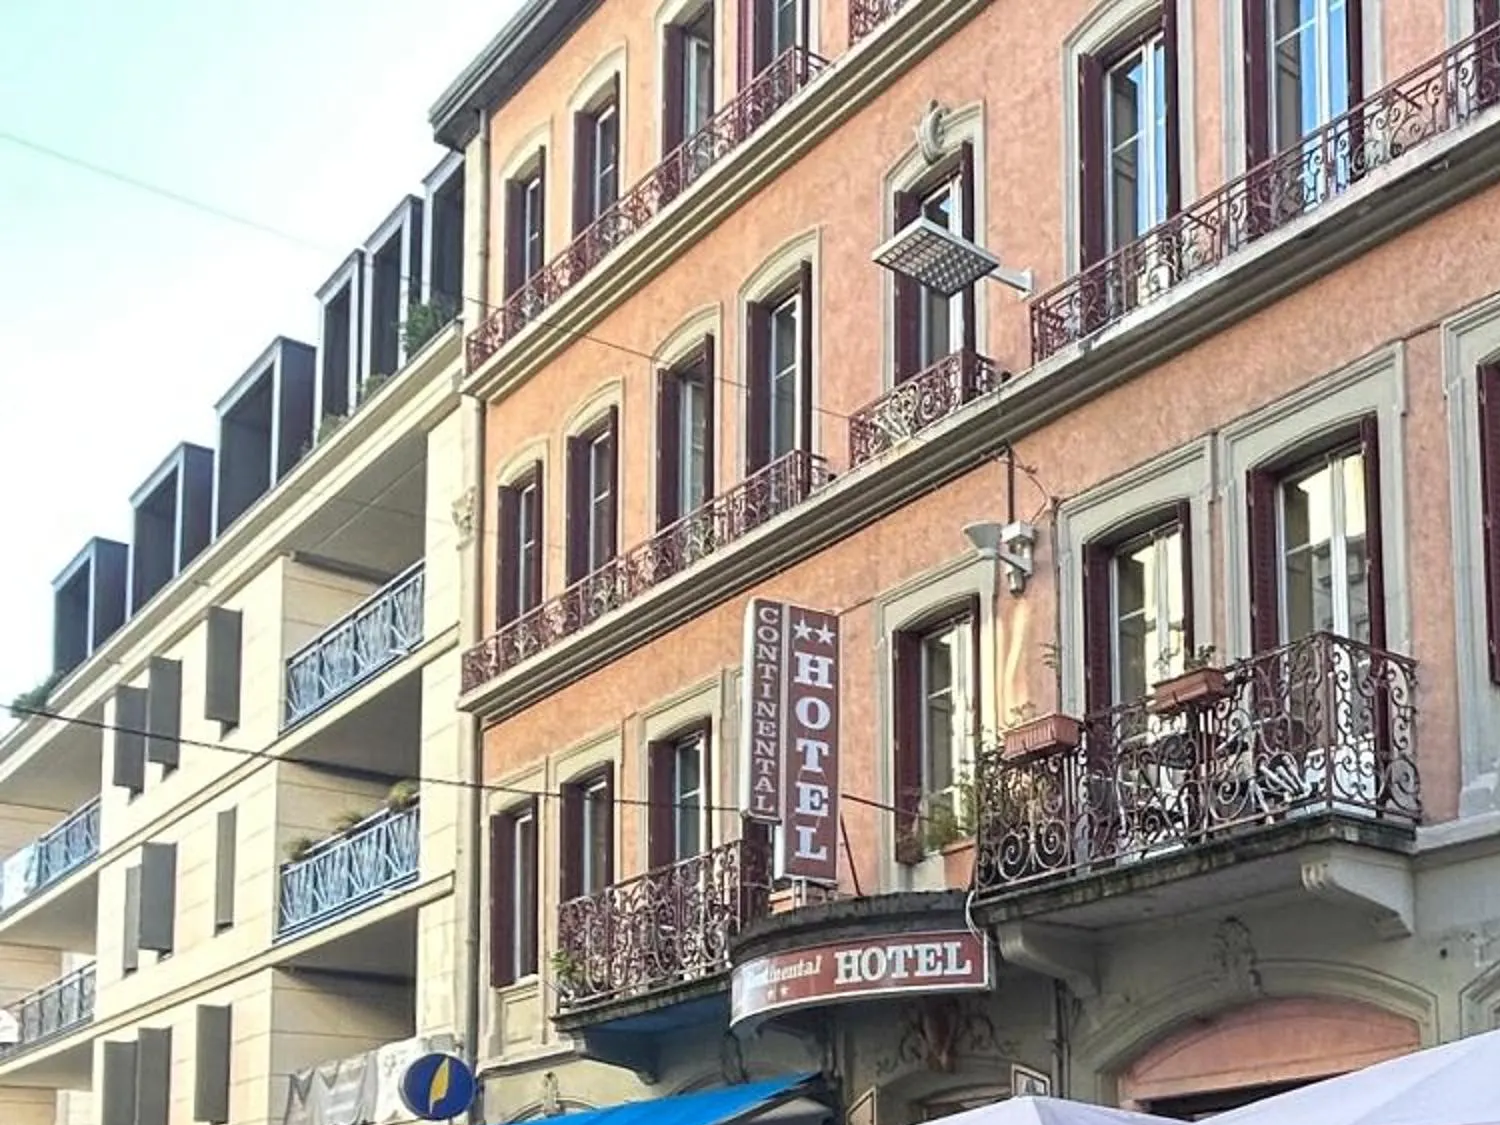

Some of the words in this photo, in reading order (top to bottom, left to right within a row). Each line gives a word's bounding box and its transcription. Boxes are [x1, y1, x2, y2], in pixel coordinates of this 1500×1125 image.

[755, 606, 779, 813] CONTINENTAL
[793, 651, 833, 861] HOTEL
[834, 941, 973, 985] HOTEL
